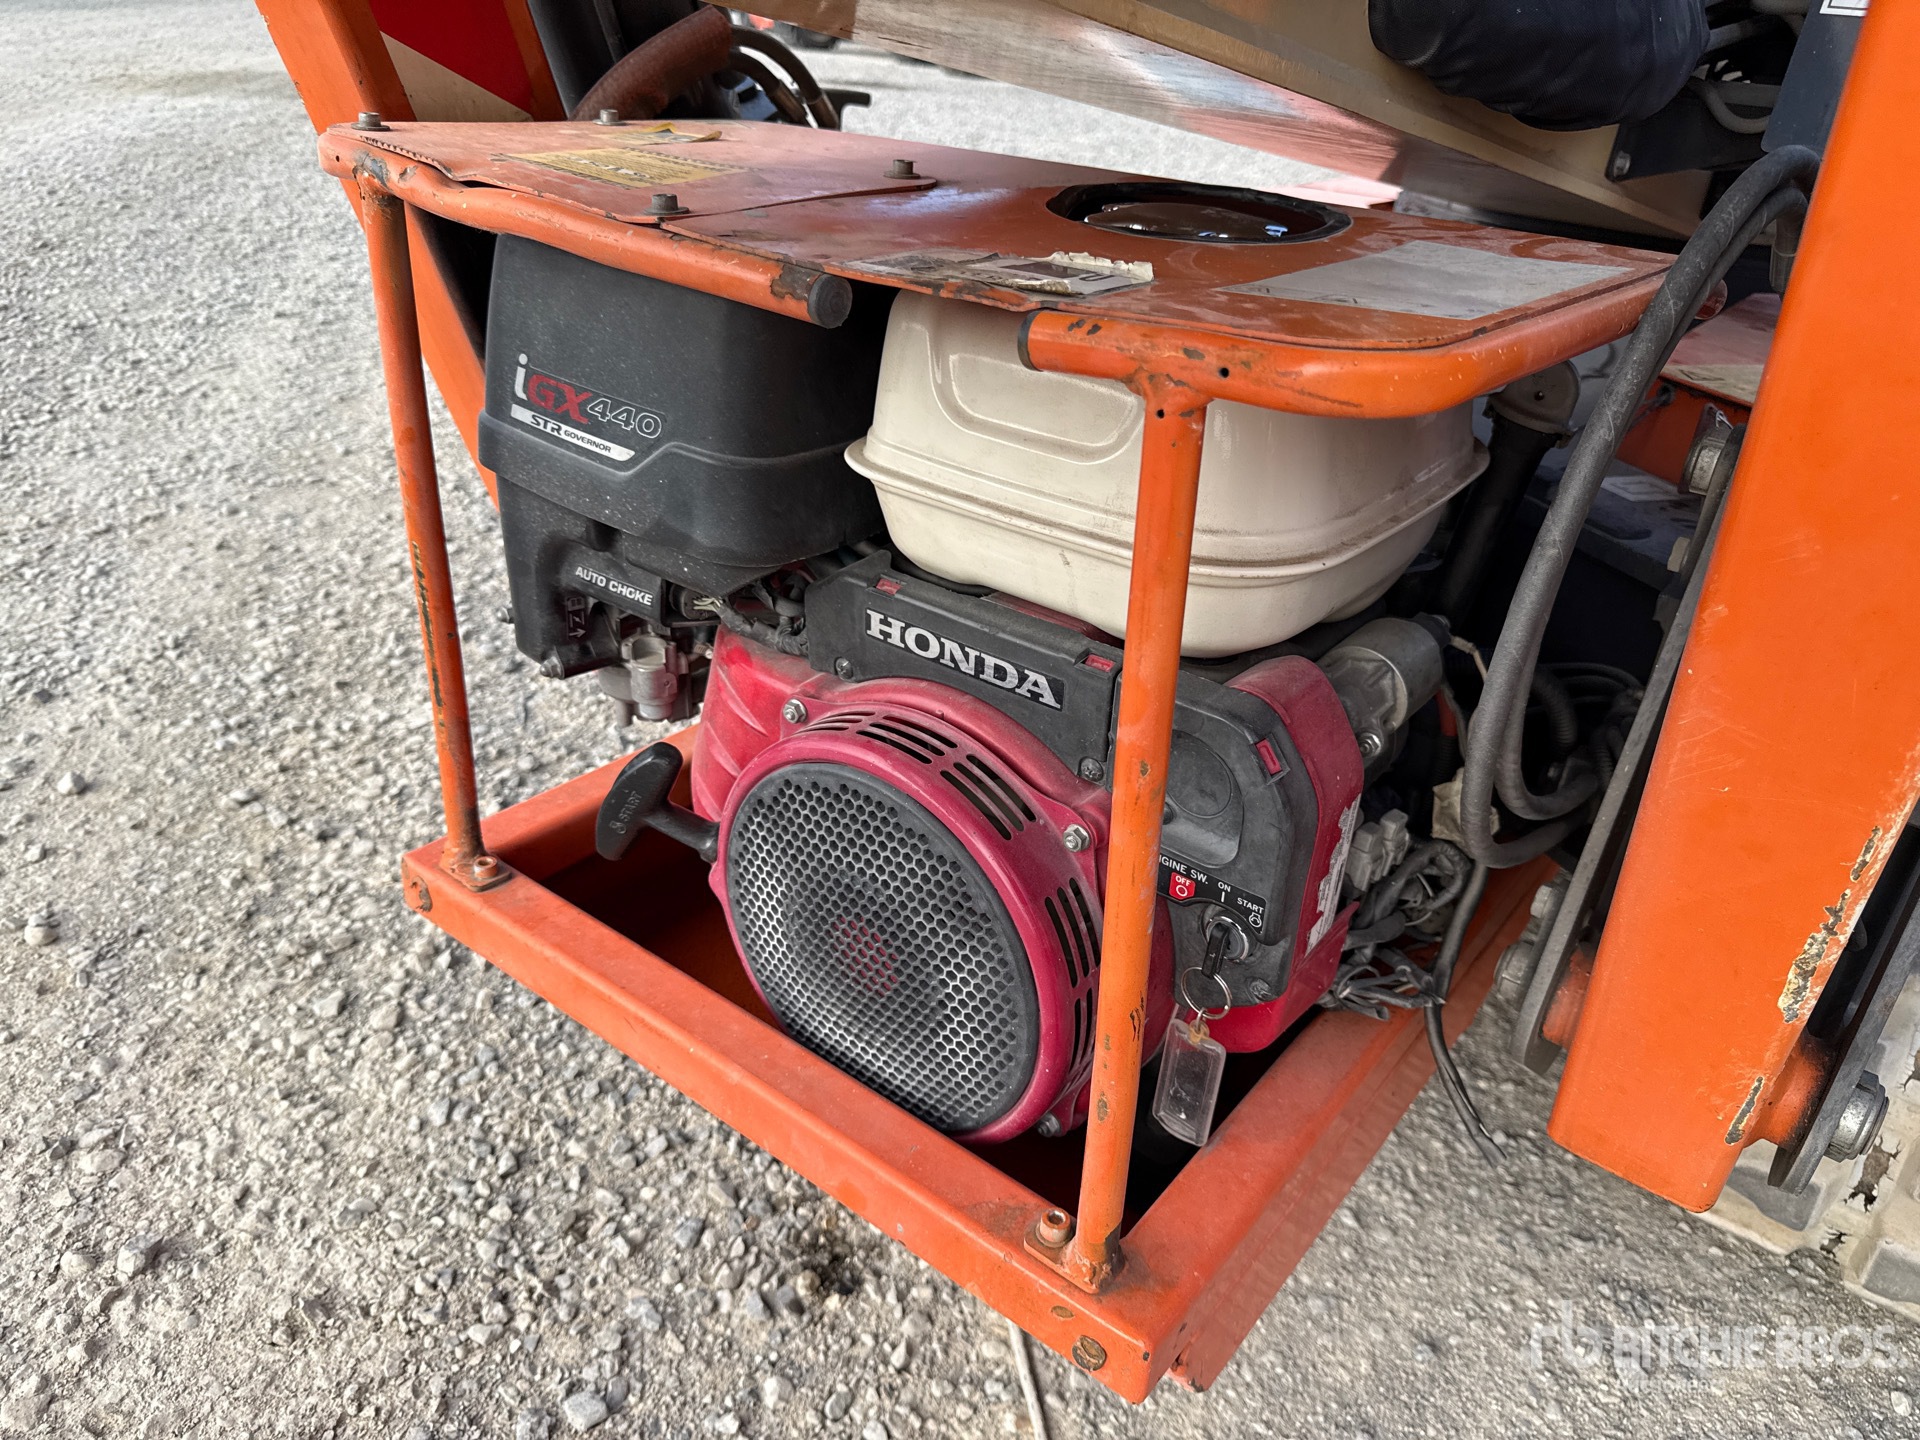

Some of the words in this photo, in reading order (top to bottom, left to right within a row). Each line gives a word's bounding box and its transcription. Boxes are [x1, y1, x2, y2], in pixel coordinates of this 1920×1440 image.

[531, 414, 563, 436] STR
[564, 429, 611, 454] GOVERNOR
[575, 566, 606, 588] AUTO
[608, 581, 654, 606] CHOKE
[866, 608, 1061, 709] HONDA
[1158, 854, 1188, 875] GINE
[1190, 869, 1209, 885] SW.
[1175, 875, 1192, 887] OFF
[1217, 881, 1231, 893] ON
[1237, 897, 1264, 914] START
